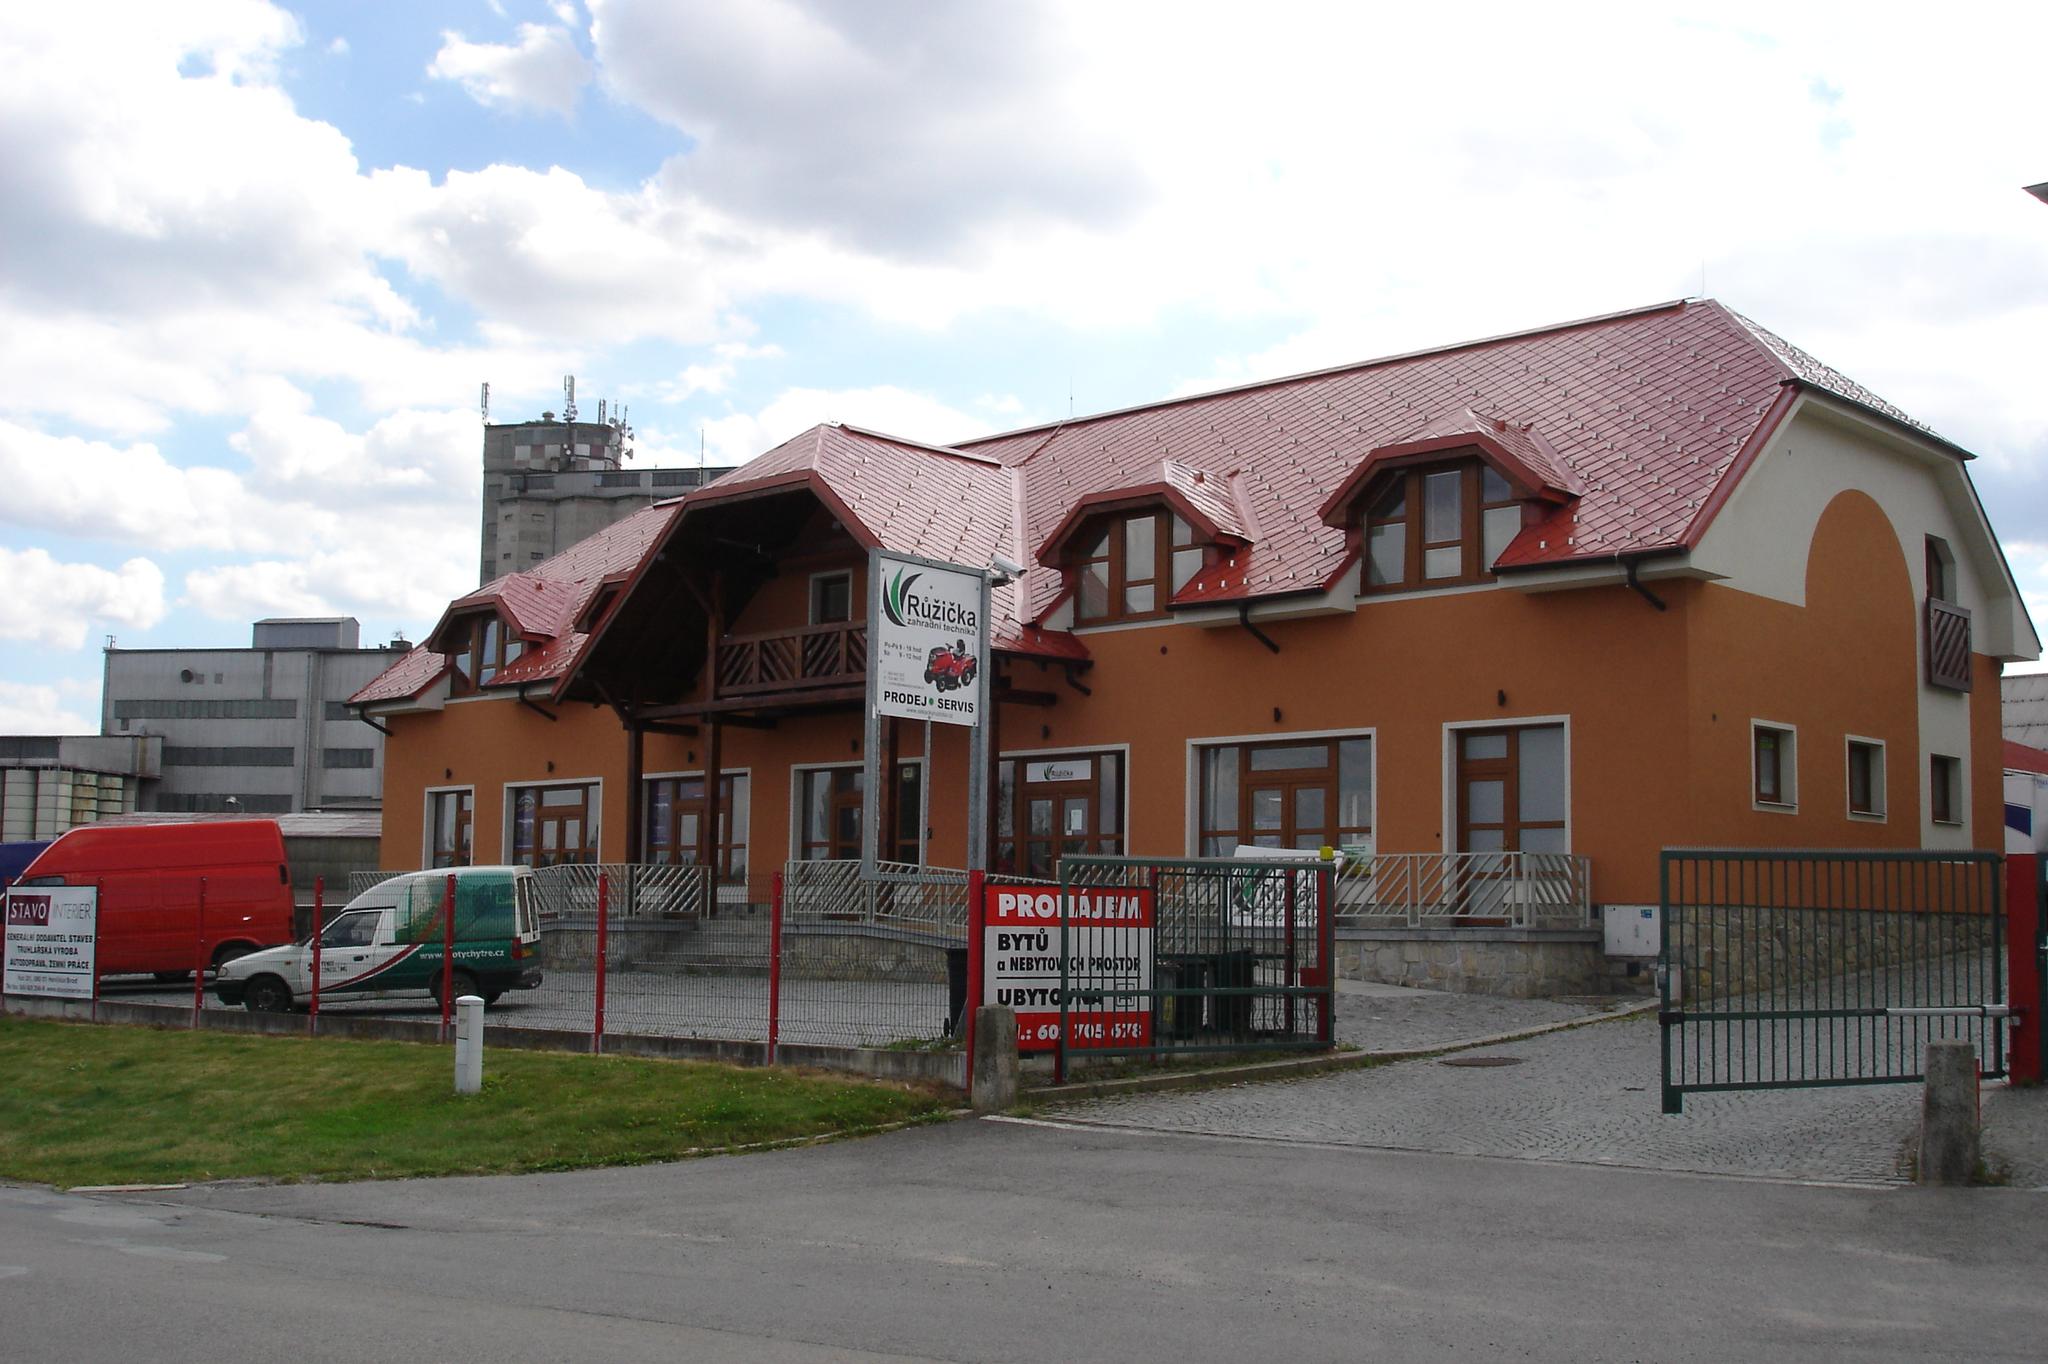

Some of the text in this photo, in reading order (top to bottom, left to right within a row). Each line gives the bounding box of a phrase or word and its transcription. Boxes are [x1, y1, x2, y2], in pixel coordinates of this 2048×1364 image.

[907, 595, 976, 627] Růžička
[944, 624, 976, 636] technika
[884, 690, 974, 713] PRODEJ SERVIS
[10, 902, 92, 920] STAVO INTERIER
[998, 888, 1142, 919] PRONÁJEM
[998, 927, 1049, 951] BYTŮ
[997, 956, 1141, 972] a NEBYTOVCH PROSTOR
[1037, 1023, 1063, 1040] 60
[1074, 1023, 1106, 1040] 705
